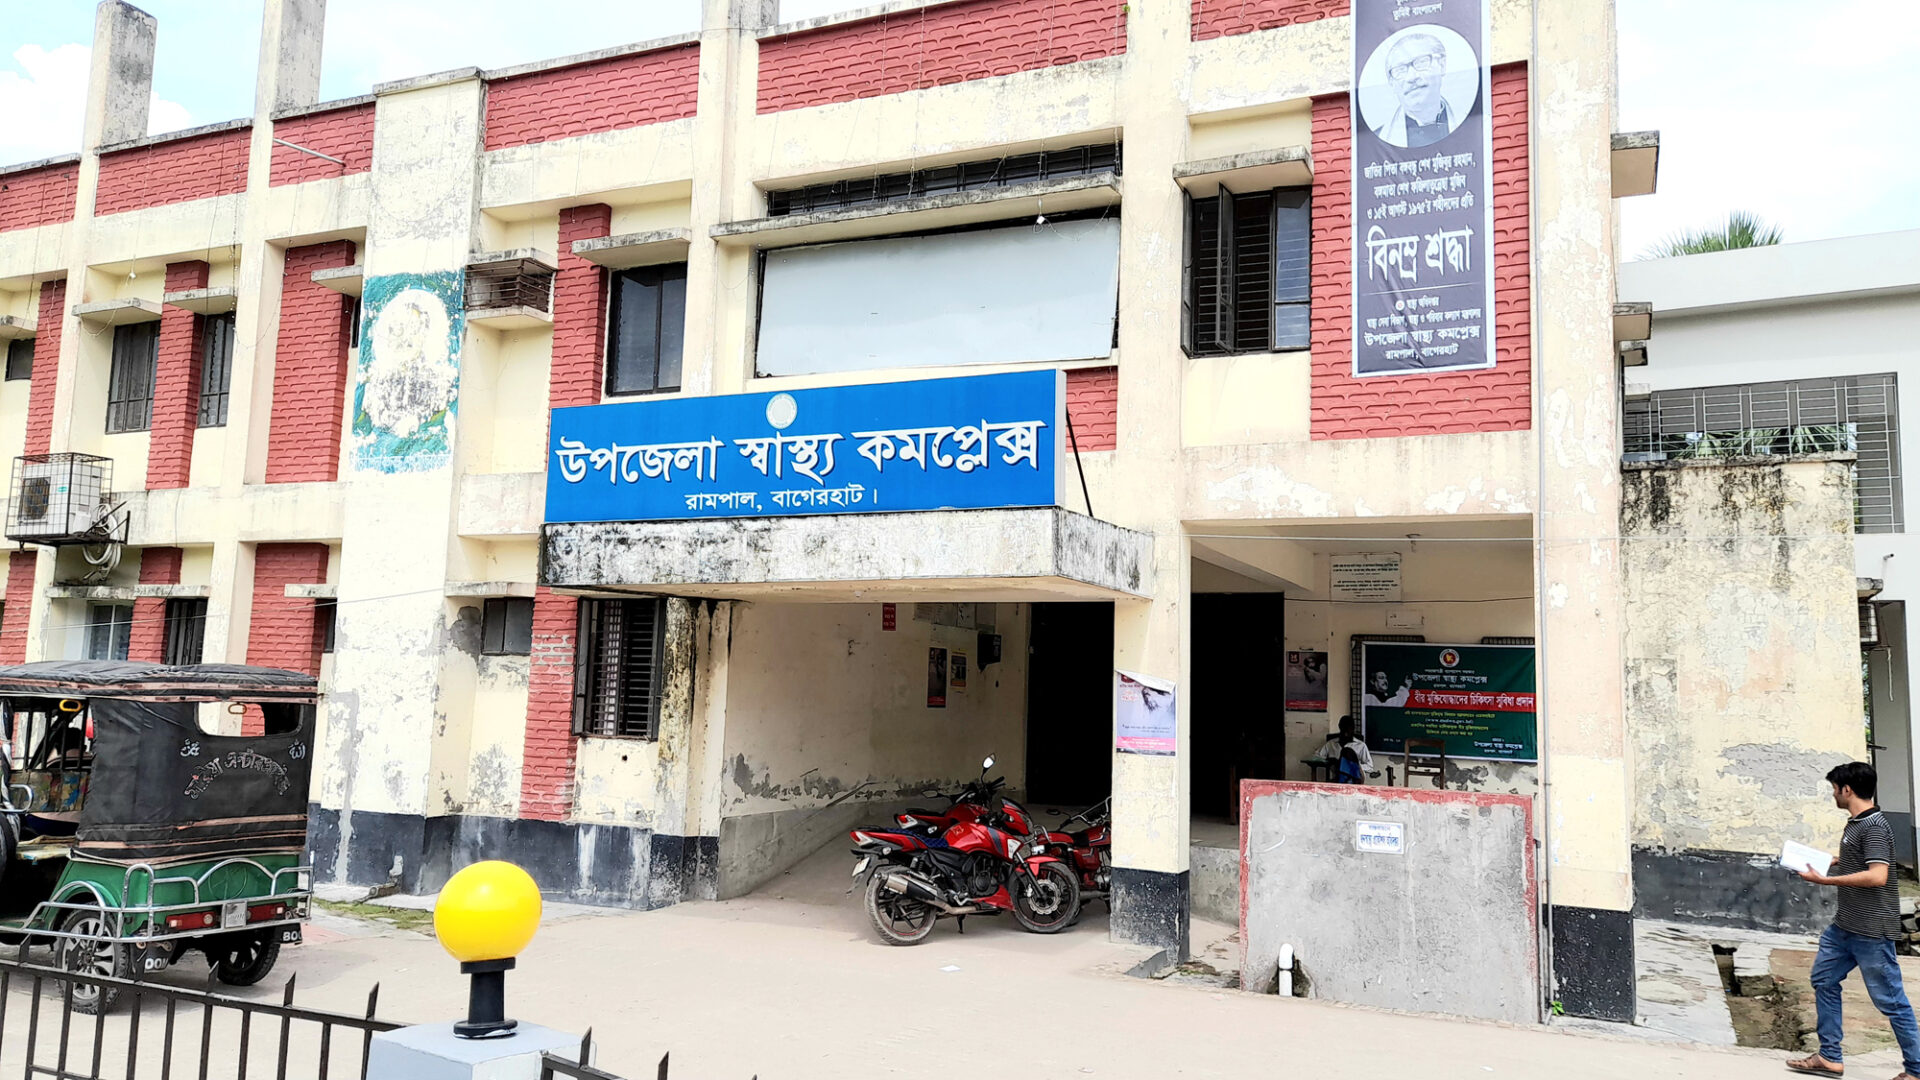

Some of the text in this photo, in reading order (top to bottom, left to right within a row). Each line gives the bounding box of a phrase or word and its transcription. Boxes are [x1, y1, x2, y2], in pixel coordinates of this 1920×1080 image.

[1365, 224, 1474, 283] বিনম্র শ্রদ্ধা
[1363, 325, 1481, 346] উপজেলা স্বাস্থ্য কমপ্লেক্স
[1420, 343, 1460, 358] বাগেরহাট
[555, 418, 1048, 487] উপজেলা স্বাস্থ্য কমপ্লেক্স
[684, 491, 763, 512] রামপাল,
[770, 482, 866, 508] বাগেরহাট
[1414, 690, 1425, 704] বীর
[1427, 691, 1468, 706] মুক্তিযোদ্ধাদের
[1496, 693, 1514, 708] সুবিধা
